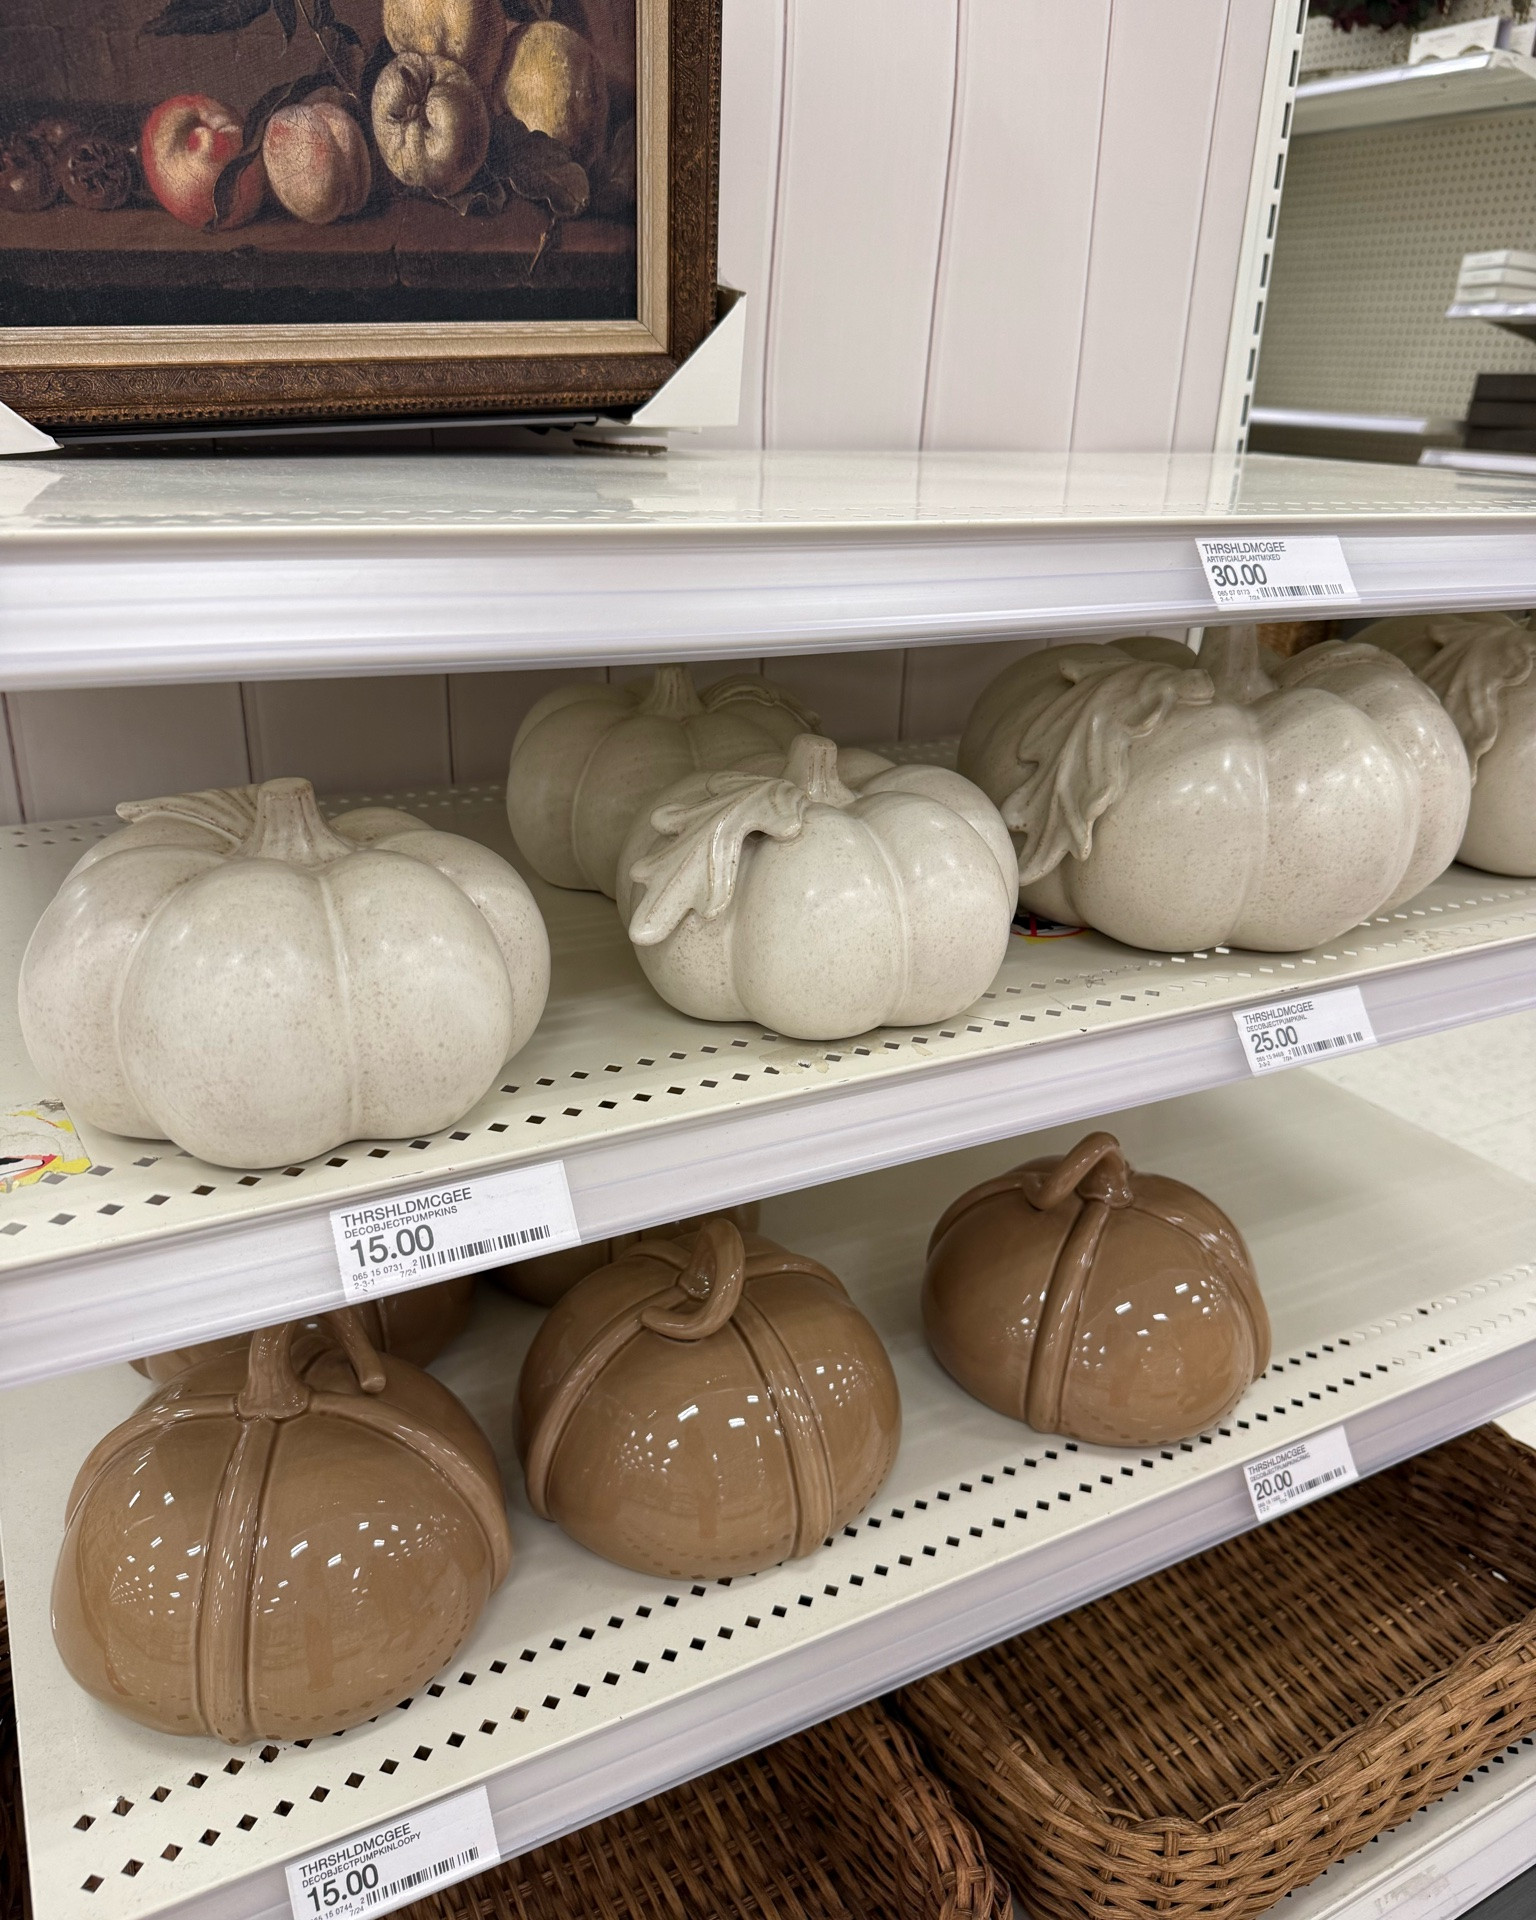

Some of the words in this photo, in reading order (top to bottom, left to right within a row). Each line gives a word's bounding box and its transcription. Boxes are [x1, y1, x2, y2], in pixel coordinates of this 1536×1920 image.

[1202, 541, 1287, 554] THRSHLDMCGEE
[1206, 554, 1281, 563] ARTIFICIALPLANTMIXED
[1211, 563, 1268, 587] 30.00
[1243, 1001, 1314, 1025] THRSHLDMCGEE
[1246, 1014, 1308, 1032] DECOBJECTPUMPKINL
[1251, 1025, 1298, 1054] 25.00
[341, 1187, 473, 1229] THRSHLDMCGEE
[344, 1205, 458, 1239] DECOBJECTPUMPKINS
[350, 1224, 435, 1267] 15.00
[352, 1271, 369, 1281] 065
[371, 1268, 381, 1277] 15
[383, 1263, 403, 1274] 0731
[354, 1278, 375, 1290] 2-3-1
[400, 1268, 417, 1278] 7/24
[1248, 1444, 1307, 1475] THRSHLDMCGEE
[1254, 1470, 1293, 1500] 20.00
[299, 1822, 411, 1878] THRSHLDMCGEE
[302, 1831, 422, 1888] DECOBJECTPUMPKINLOOPY
[307, 1863, 379, 1912] 15.00
[325, 1910, 334, 1919] 15
[335, 1902, 353, 1915] 0744
[350, 1905, 365, 1916] 7/24
